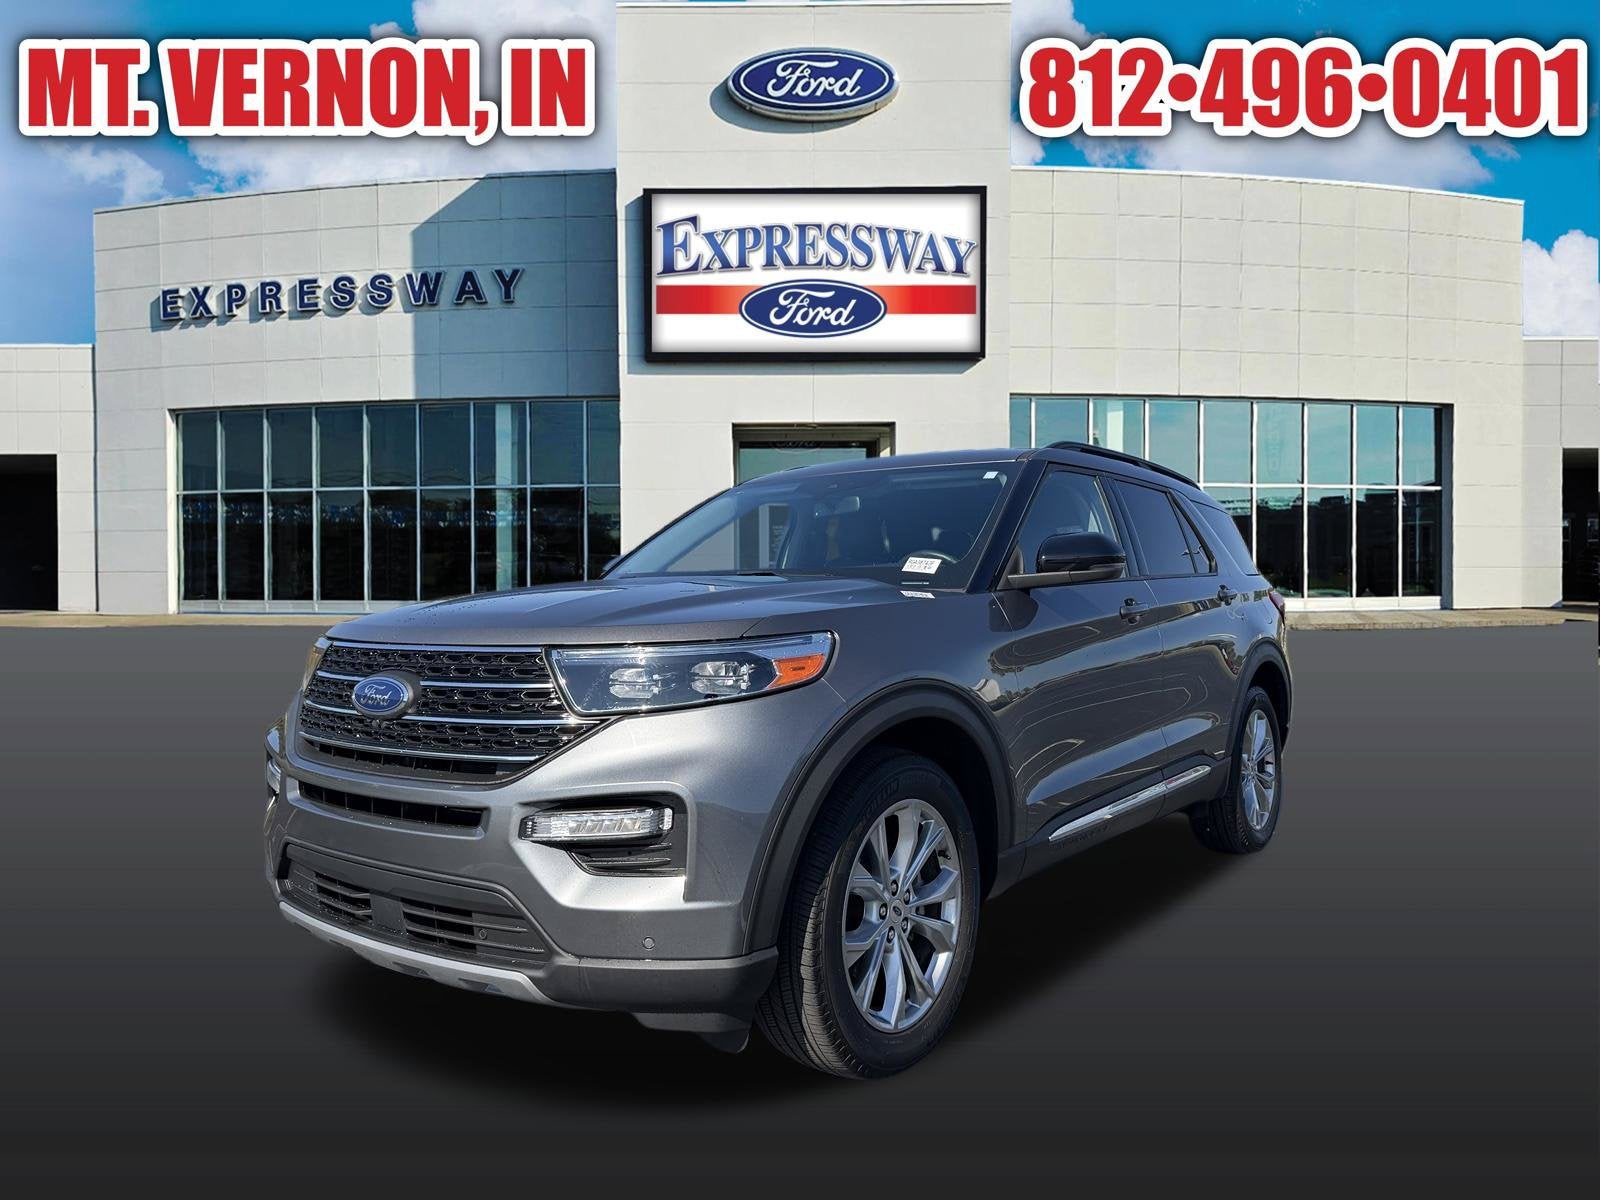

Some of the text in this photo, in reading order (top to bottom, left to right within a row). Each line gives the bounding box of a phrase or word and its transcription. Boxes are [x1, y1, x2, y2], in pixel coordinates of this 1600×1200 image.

[766, 59, 863, 97] Ford
[655, 215, 977, 277] EXPRESSWAY
[159, 267, 525, 322] EXPRESSWAY
[769, 290, 857, 327] Ford
[360, 683, 393, 706] Ford
